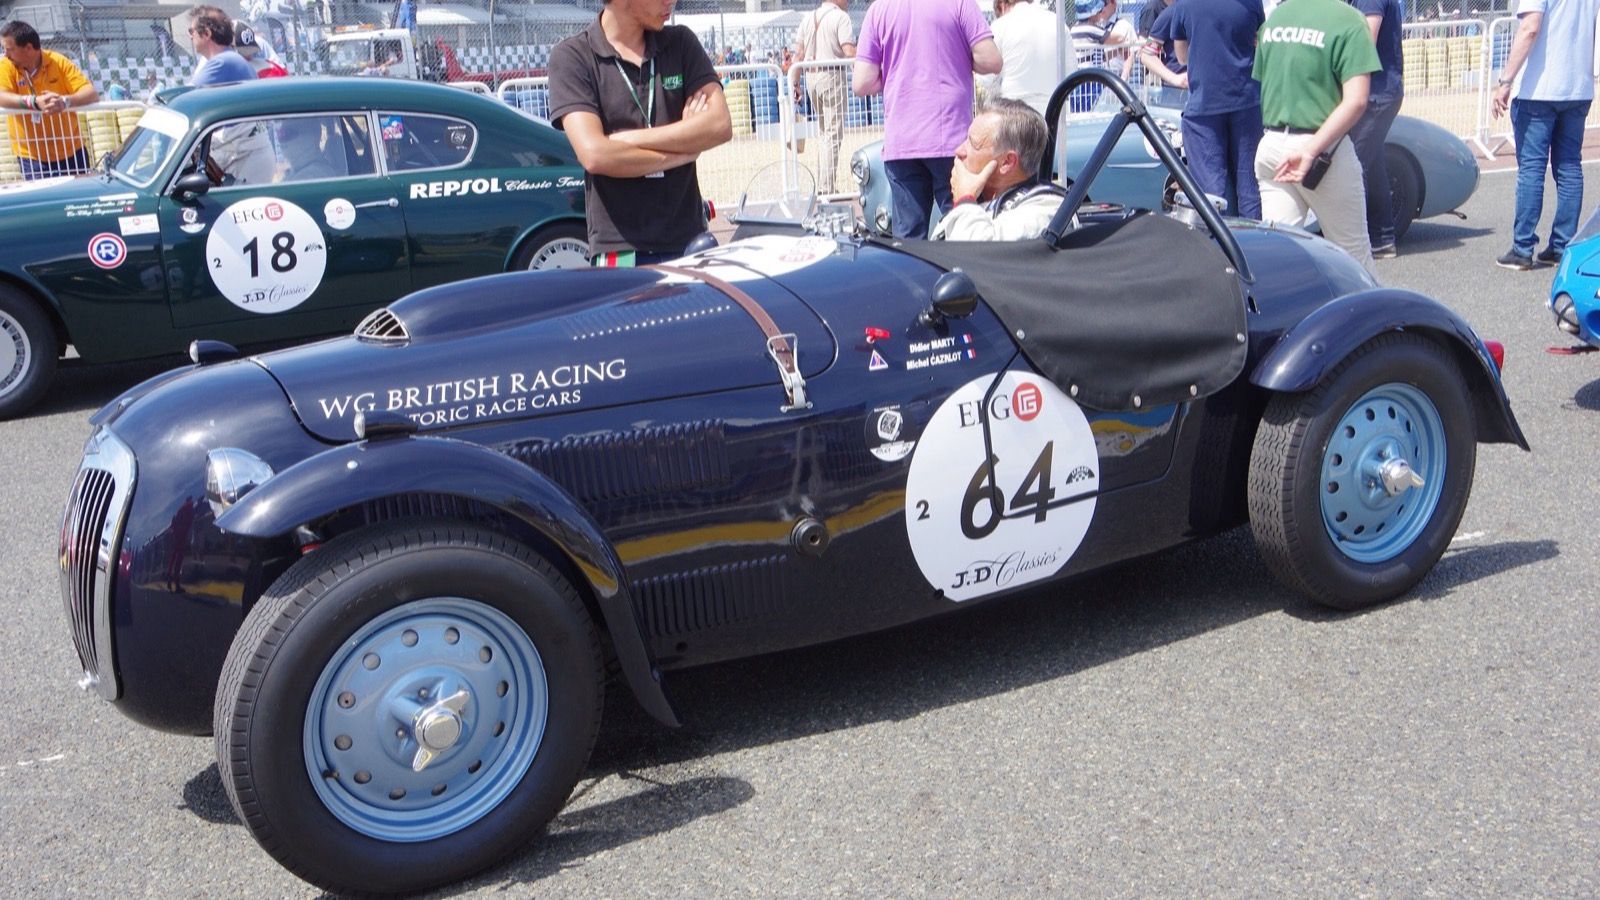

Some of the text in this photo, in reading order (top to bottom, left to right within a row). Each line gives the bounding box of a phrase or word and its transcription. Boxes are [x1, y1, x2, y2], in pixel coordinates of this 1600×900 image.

[1262, 26, 1325, 49] ACCUEIL
[409, 177, 502, 200] REPSOL
[504, 180, 552, 192] Classic
[233, 207, 264, 224] EFG
[213, 257, 222, 268] 2
[242, 231, 298, 278] 18
[268, 283, 308, 304] Classics
[909, 336, 956, 354] Didier MARTY
[906, 357, 930, 371] Michel
[318, 358, 628, 420] WG BRITISH RACING
[408, 389, 582, 426] TORIC RACE CARS
[960, 439, 1056, 540] 64
[915, 499, 931, 521] 2
[995, 550, 1058, 587] Classics
